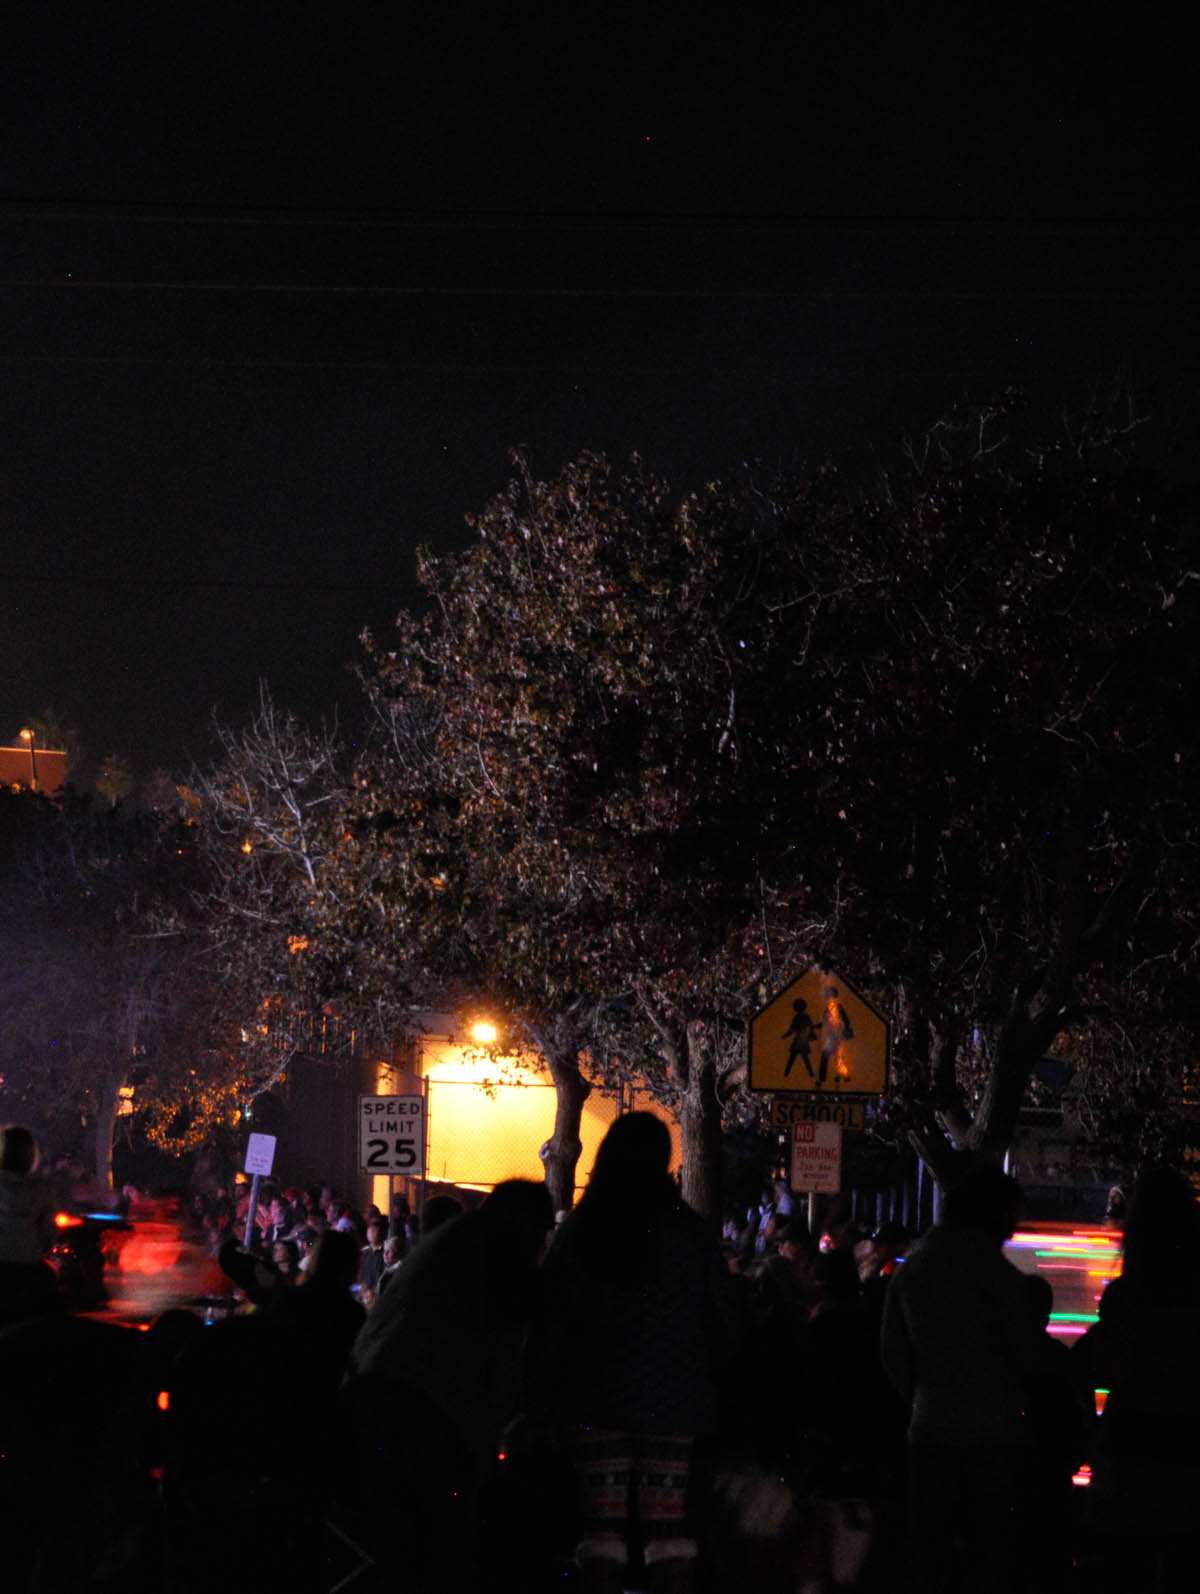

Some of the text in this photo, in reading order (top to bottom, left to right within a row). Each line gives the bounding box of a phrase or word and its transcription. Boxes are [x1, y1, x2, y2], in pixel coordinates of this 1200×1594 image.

[364, 1103, 420, 1115] SPEED
[776, 1104, 860, 1127] SCHOOL
[368, 1121, 414, 1133] LIMIT
[796, 1125, 813, 1142] NO
[367, 1139, 416, 1167] 25
[798, 1145, 838, 1160] PARKING
